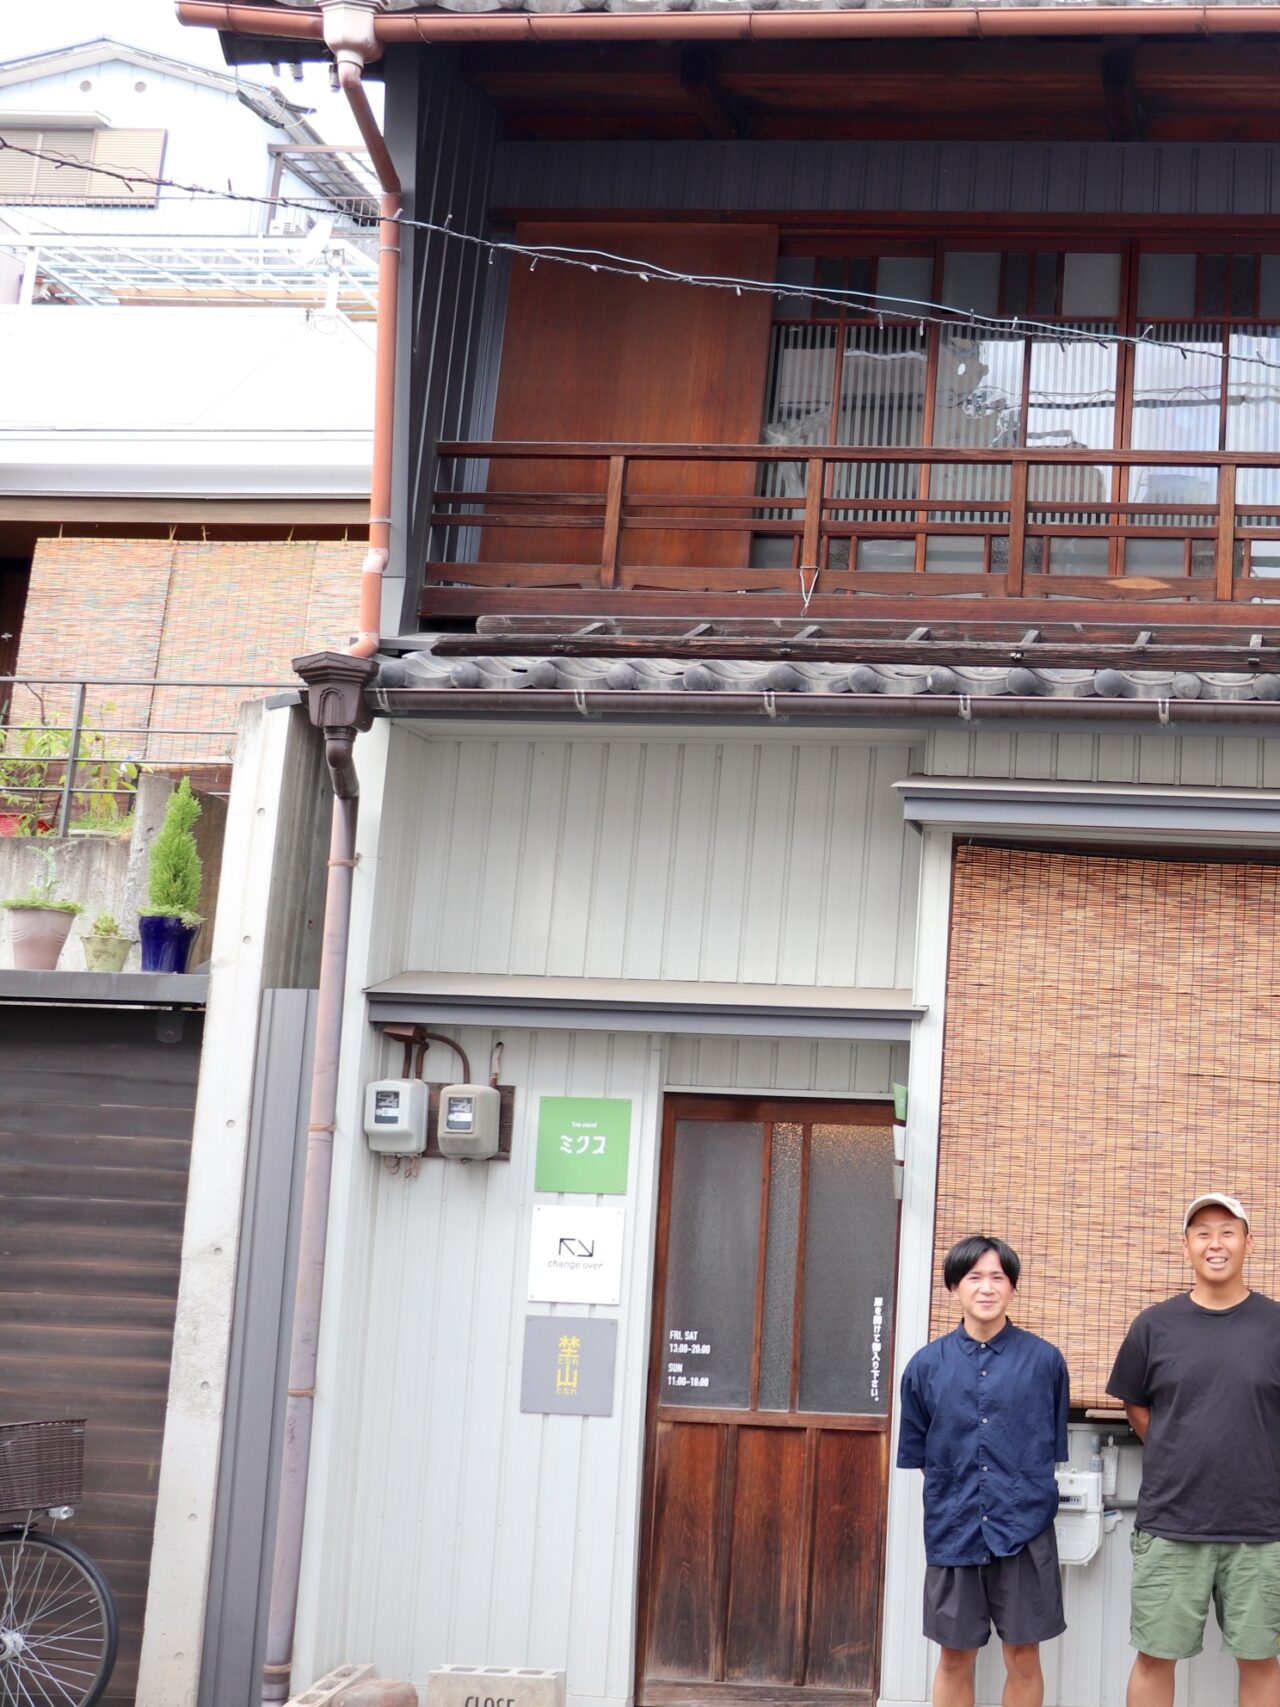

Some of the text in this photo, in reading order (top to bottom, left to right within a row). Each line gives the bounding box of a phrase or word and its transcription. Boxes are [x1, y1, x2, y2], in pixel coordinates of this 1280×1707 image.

[559, 1134, 606, 1154] ミクス
[547, 1259, 603, 1270] change over
[684, 1331, 698, 1341] SAT
[668, 1363, 683, 1373] SUN
